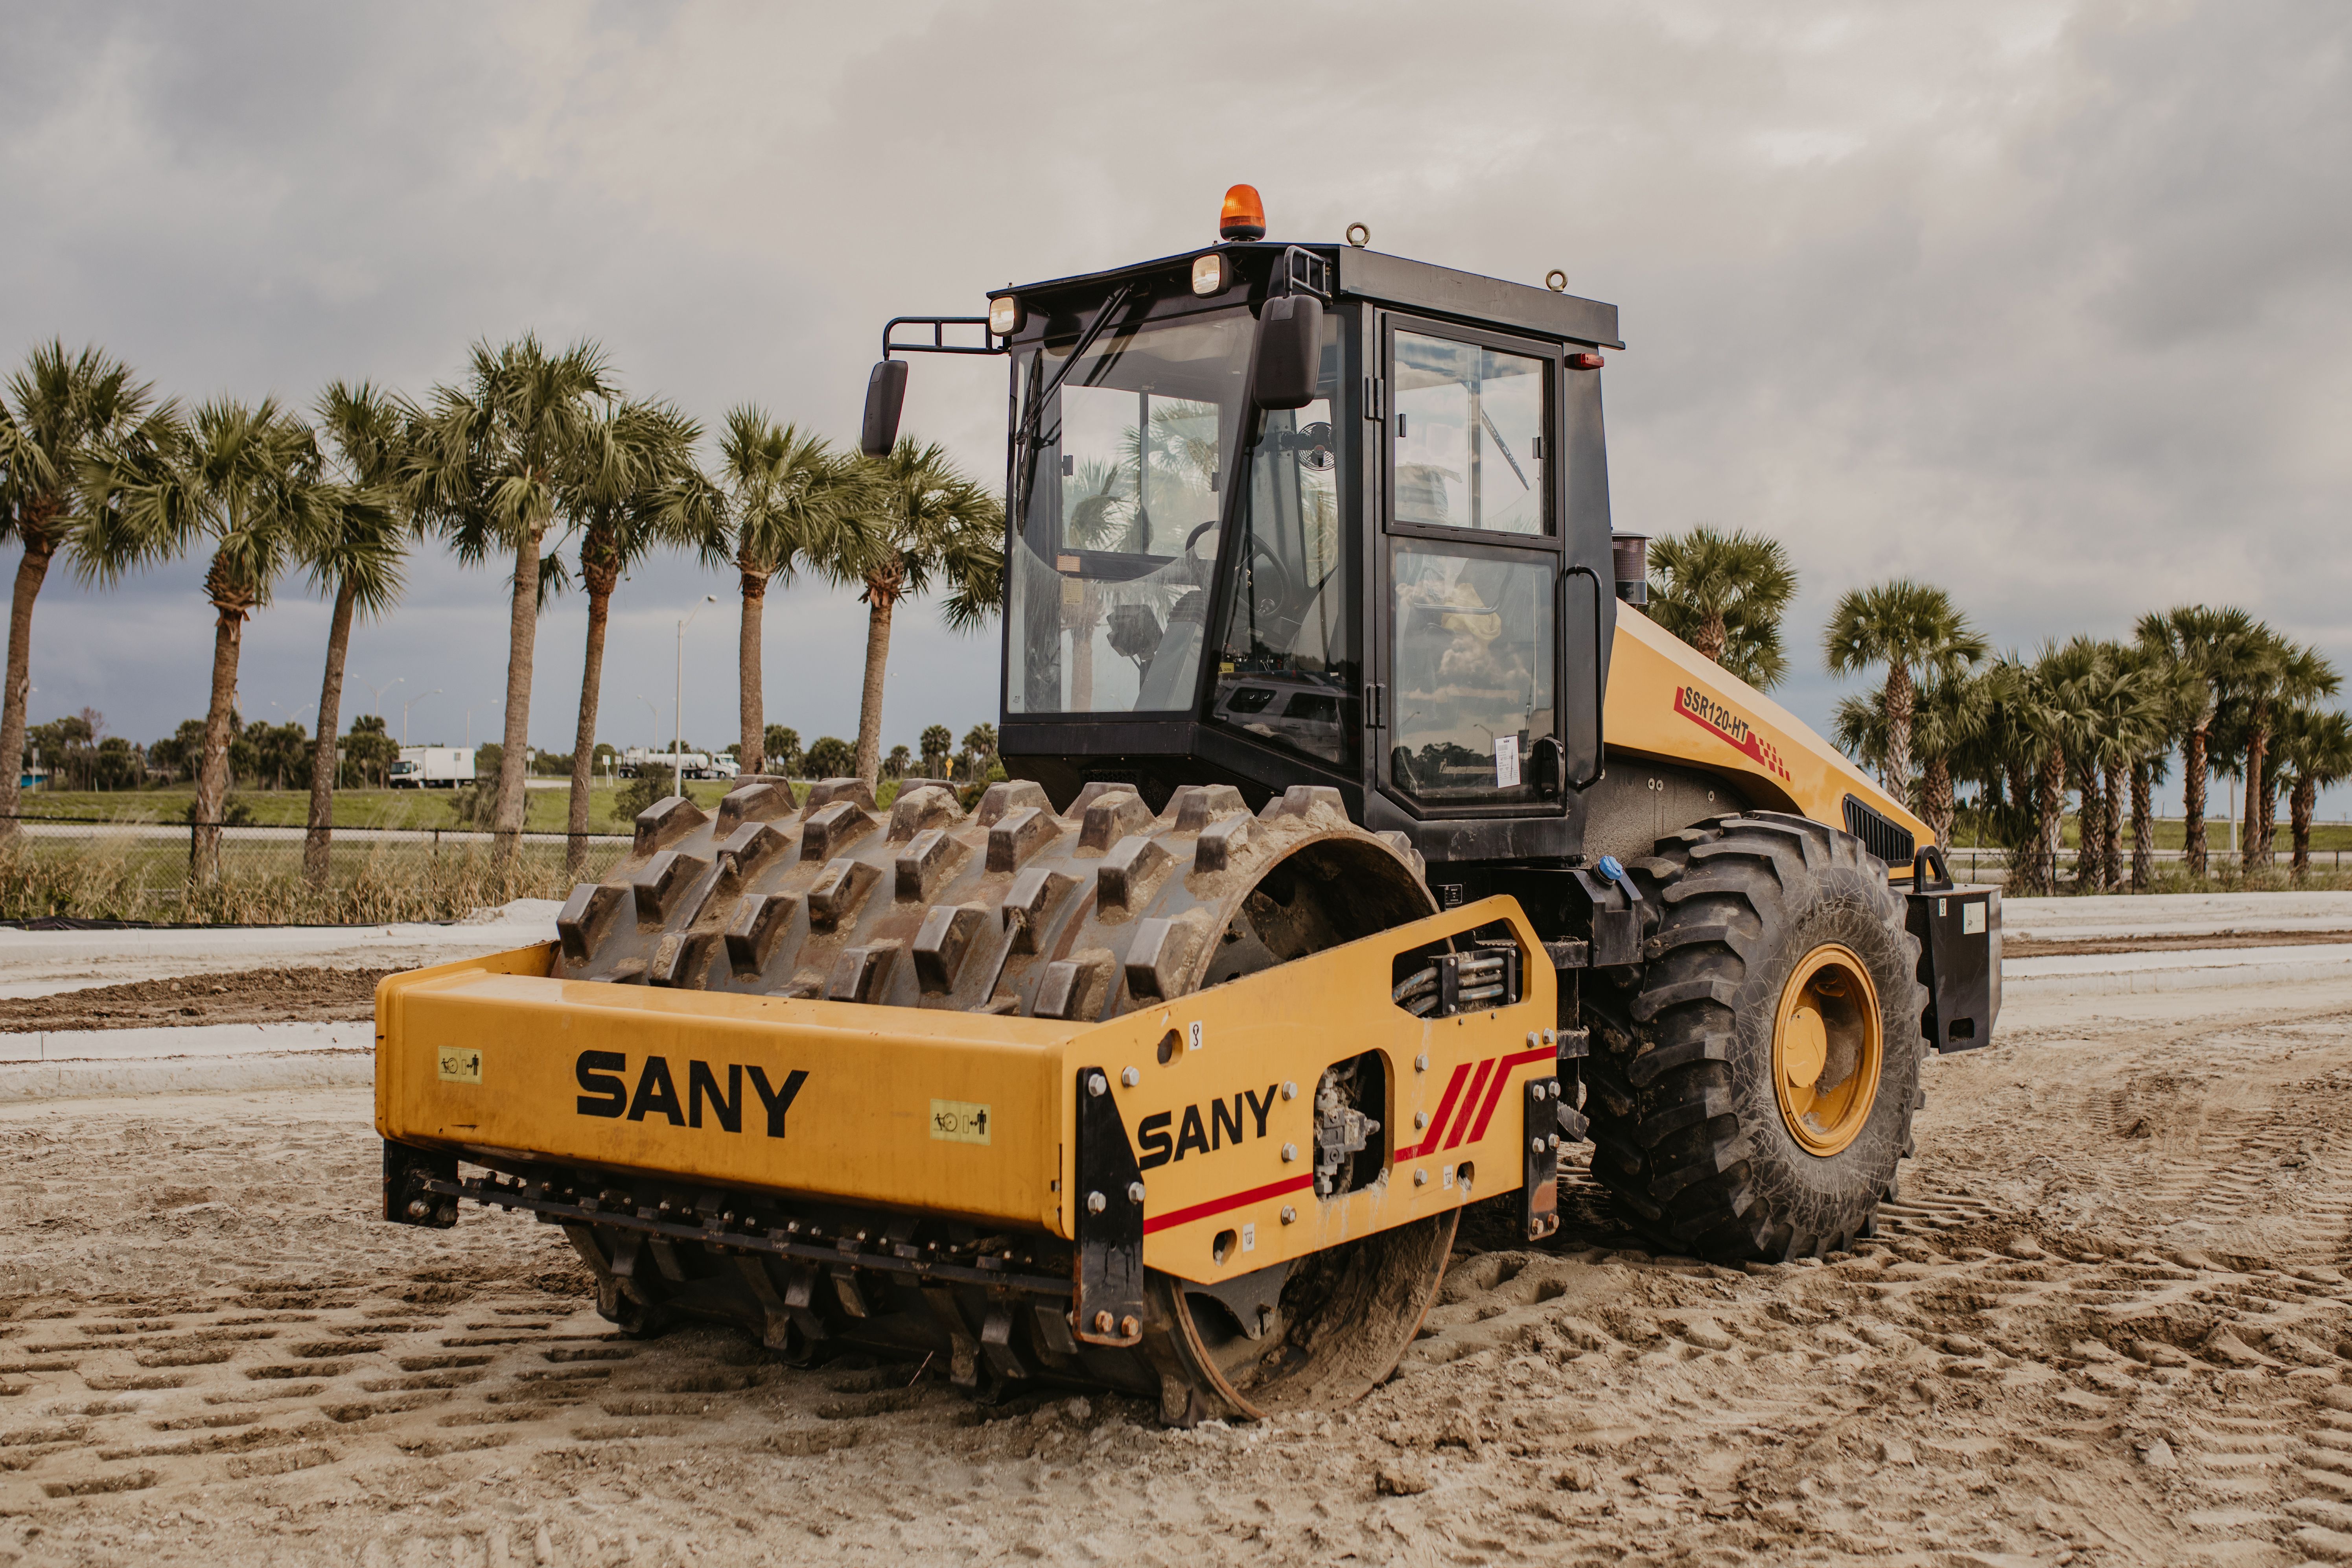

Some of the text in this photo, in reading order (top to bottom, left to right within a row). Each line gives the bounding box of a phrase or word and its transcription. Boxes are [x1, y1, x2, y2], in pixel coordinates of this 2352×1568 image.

[1684, 686, 1749, 742] SSR120-HT
[576, 1050, 809, 1138] SANY
[1138, 1083, 1278, 1172] SANY
